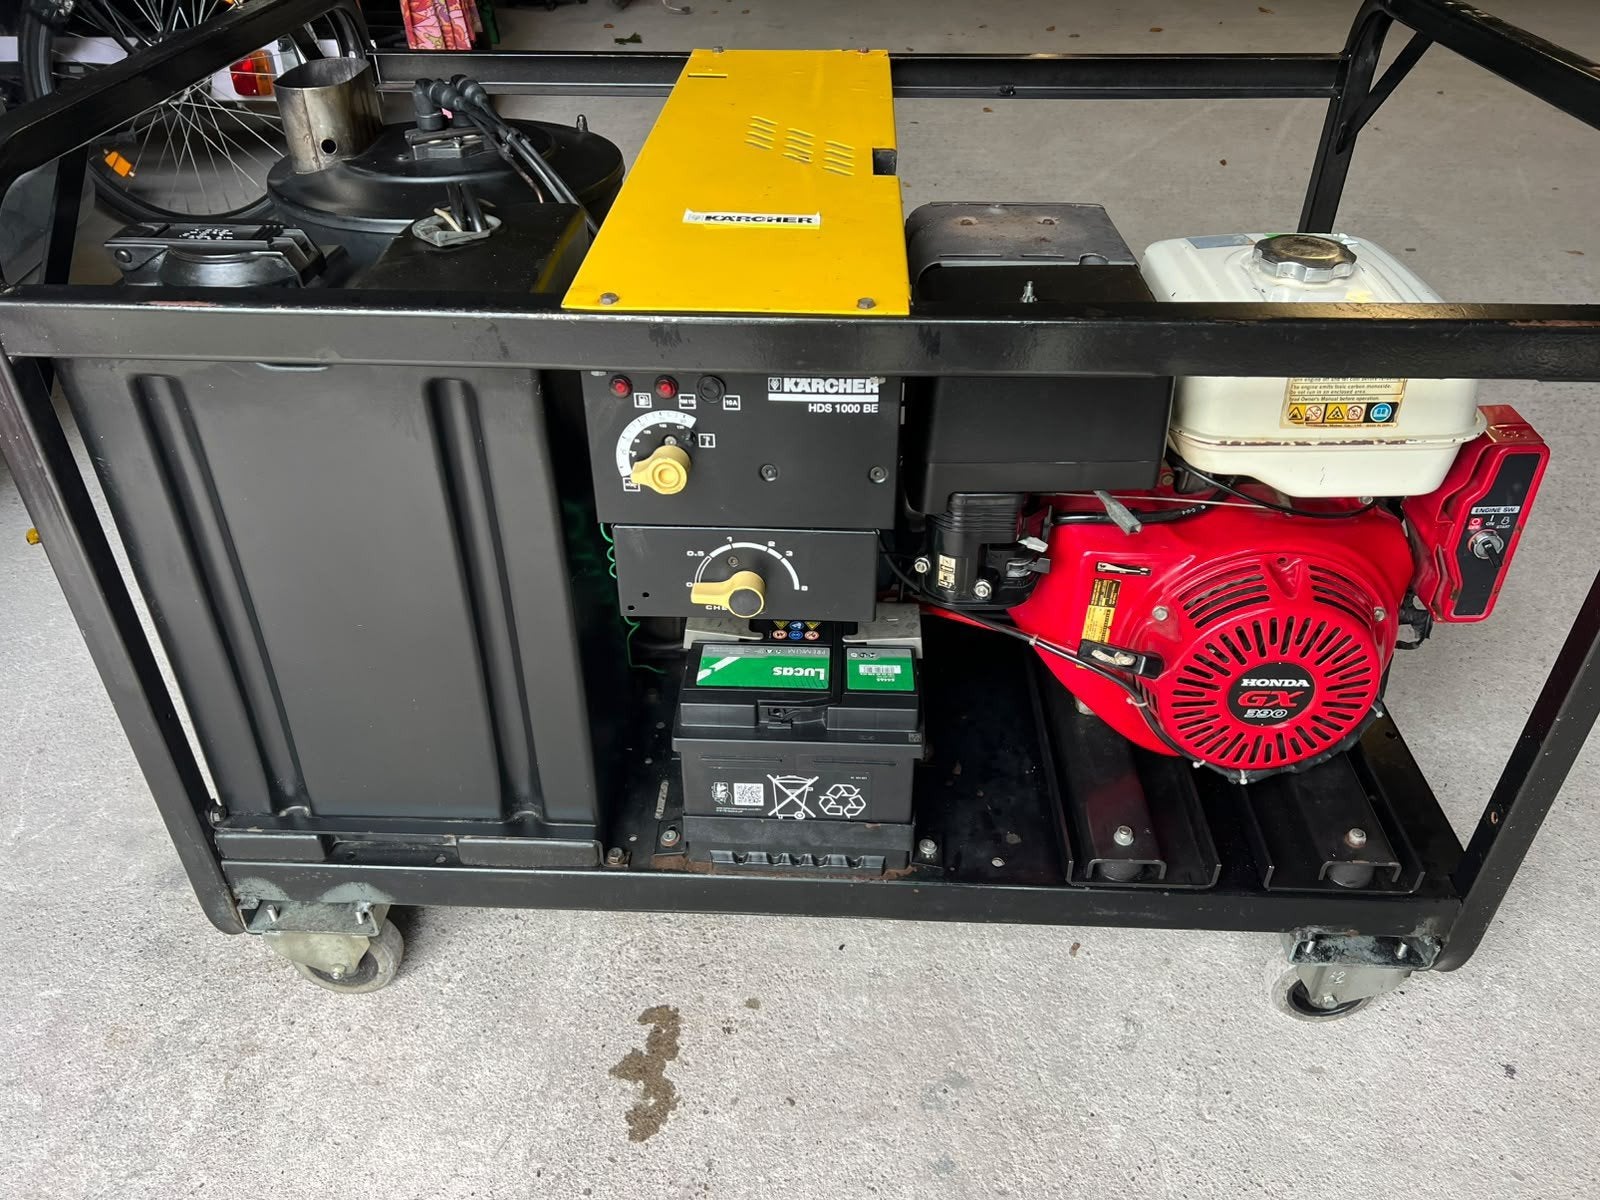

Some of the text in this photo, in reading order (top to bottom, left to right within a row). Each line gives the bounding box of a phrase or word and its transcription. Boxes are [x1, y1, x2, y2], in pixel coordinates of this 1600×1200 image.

[783, 377, 879, 393] KÄRCHER
[808, 403, 878, 413] HDS 1000 BE
[773, 666, 825, 681] Lucas
[1241, 678, 1310, 687] HONDA
[1238, 690, 1304, 707] GX
[1244, 708, 1288, 718] 390
